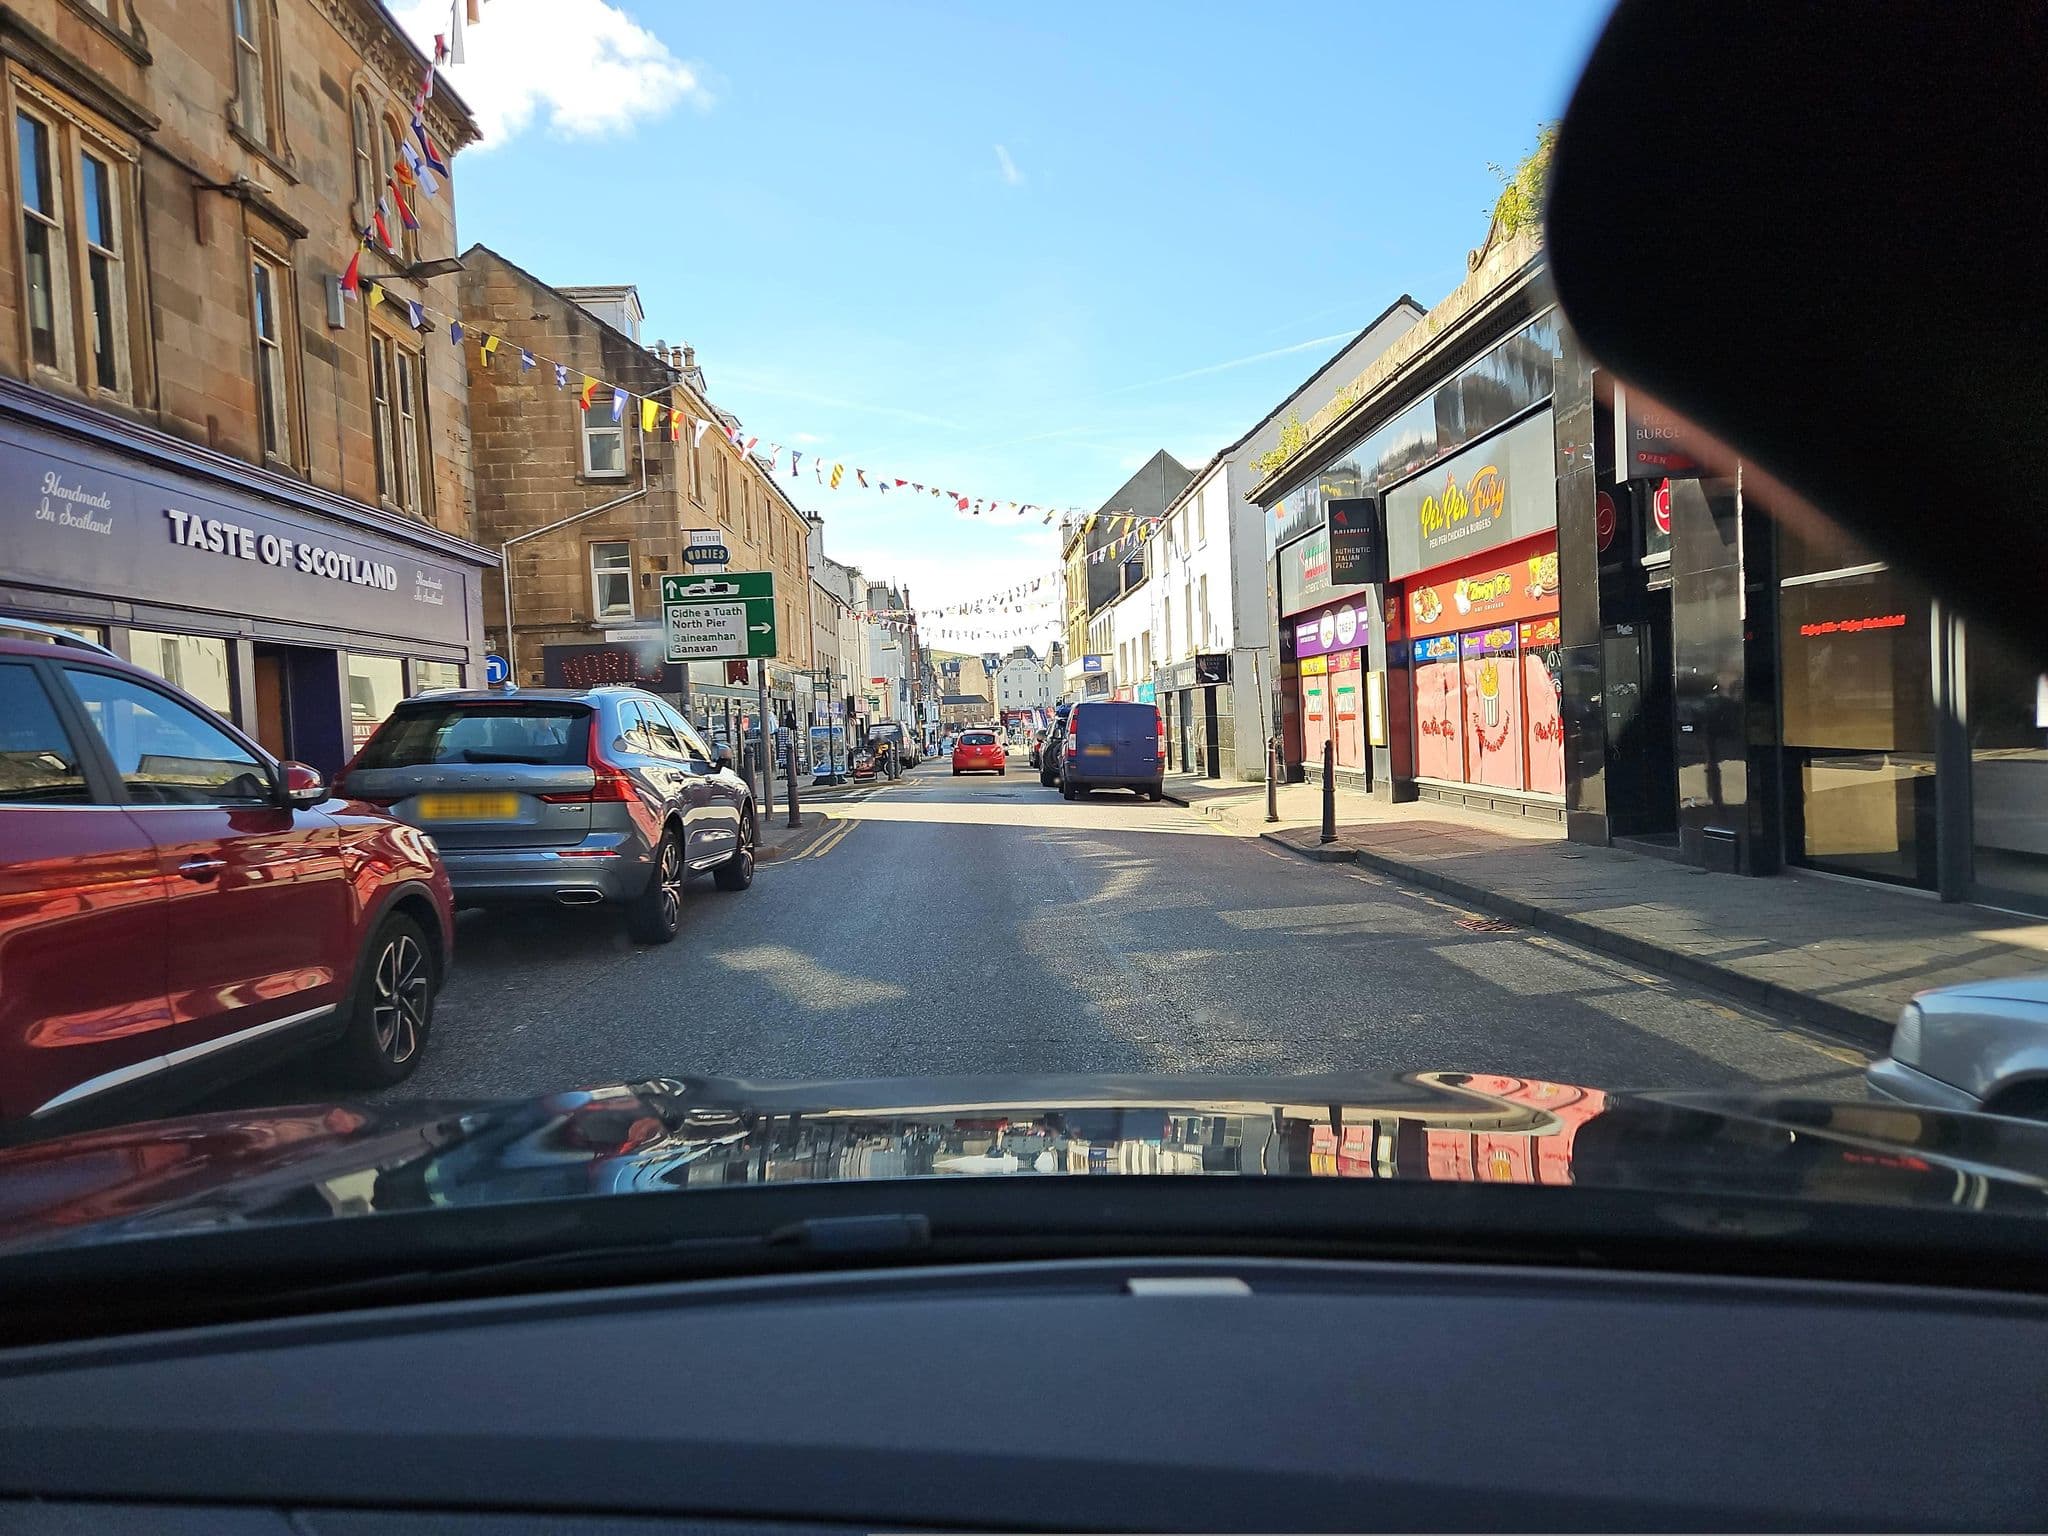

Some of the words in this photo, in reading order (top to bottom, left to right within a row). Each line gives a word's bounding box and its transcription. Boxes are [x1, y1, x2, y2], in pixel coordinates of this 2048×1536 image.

[41, 471, 111, 510] Handmade
[35, 496, 56, 523] In
[59, 502, 113, 535] Scotland
[168, 508, 257, 561] TASTE
[261, 534, 293, 568] OF
[298, 542, 398, 591] SCOTLAND
[687, 549, 725, 561] NORIES
[1335, 546, 1371, 555] AUTHENTIC
[671, 609, 702, 618] Cidhe
[713, 606, 743, 616] Tuath
[672, 620, 703, 629] North
[706, 618, 727, 628] Pier
[673, 632, 736, 643] Gaineamhan
[673, 644, 718, 654] Ganavan
